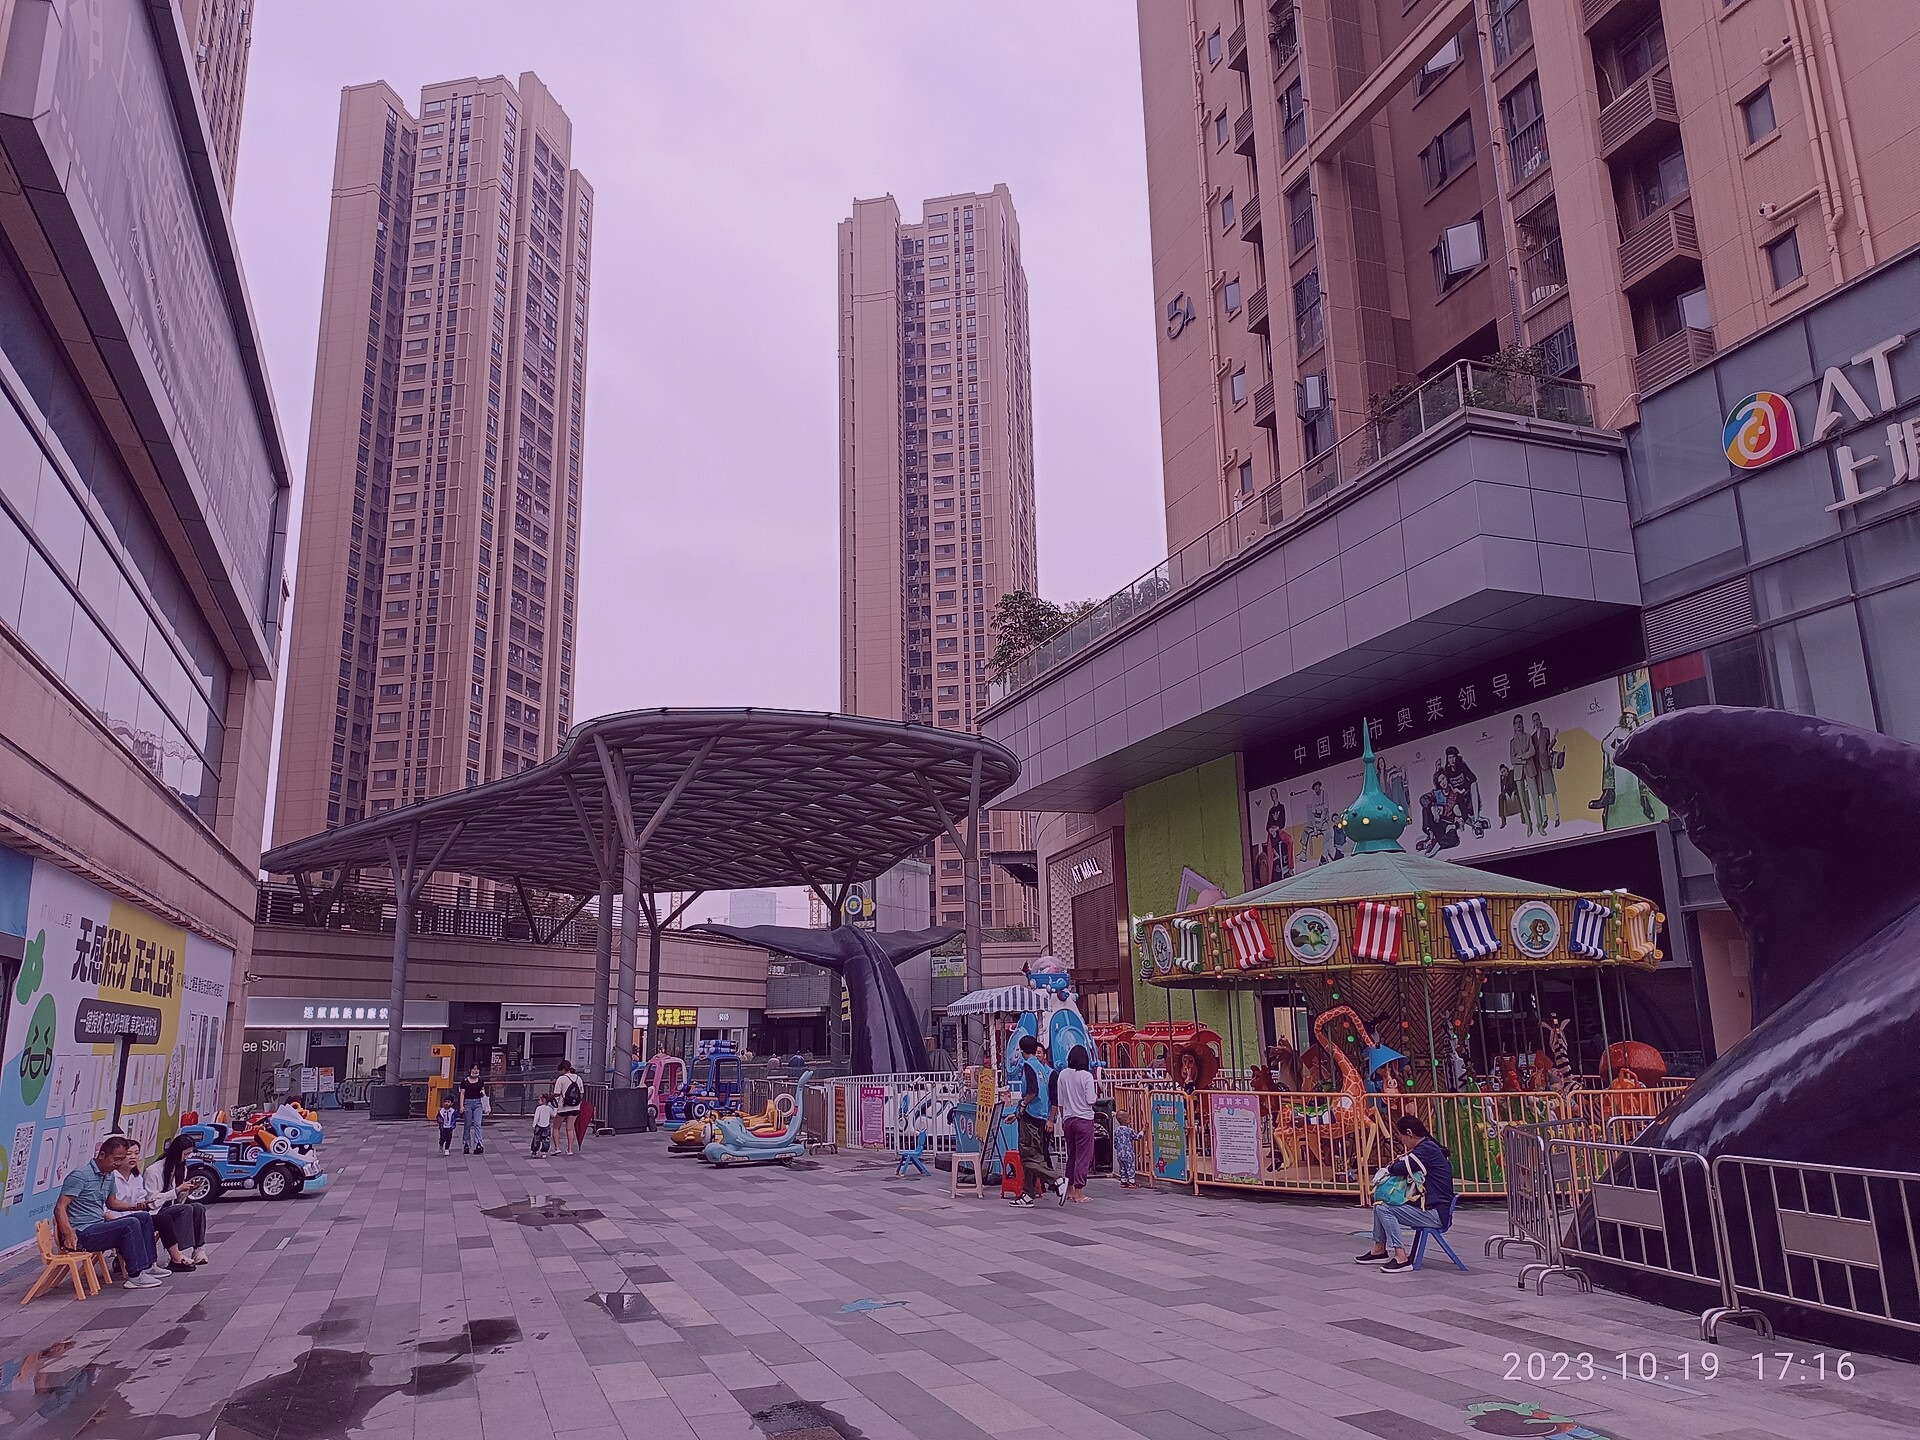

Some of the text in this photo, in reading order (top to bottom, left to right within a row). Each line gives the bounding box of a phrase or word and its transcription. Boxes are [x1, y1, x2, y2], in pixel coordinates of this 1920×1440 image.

[1167, 290, 1197, 339] 5A
[1812, 334, 1906, 442] AT
[1293, 660, 1548, 765] 中国城市奥莱领导者
[1071, 857, 1103, 884] AT MALL
[71, 916, 175, 998] 无感积分 正式上线
[261, 1040, 286, 1052] Skin
